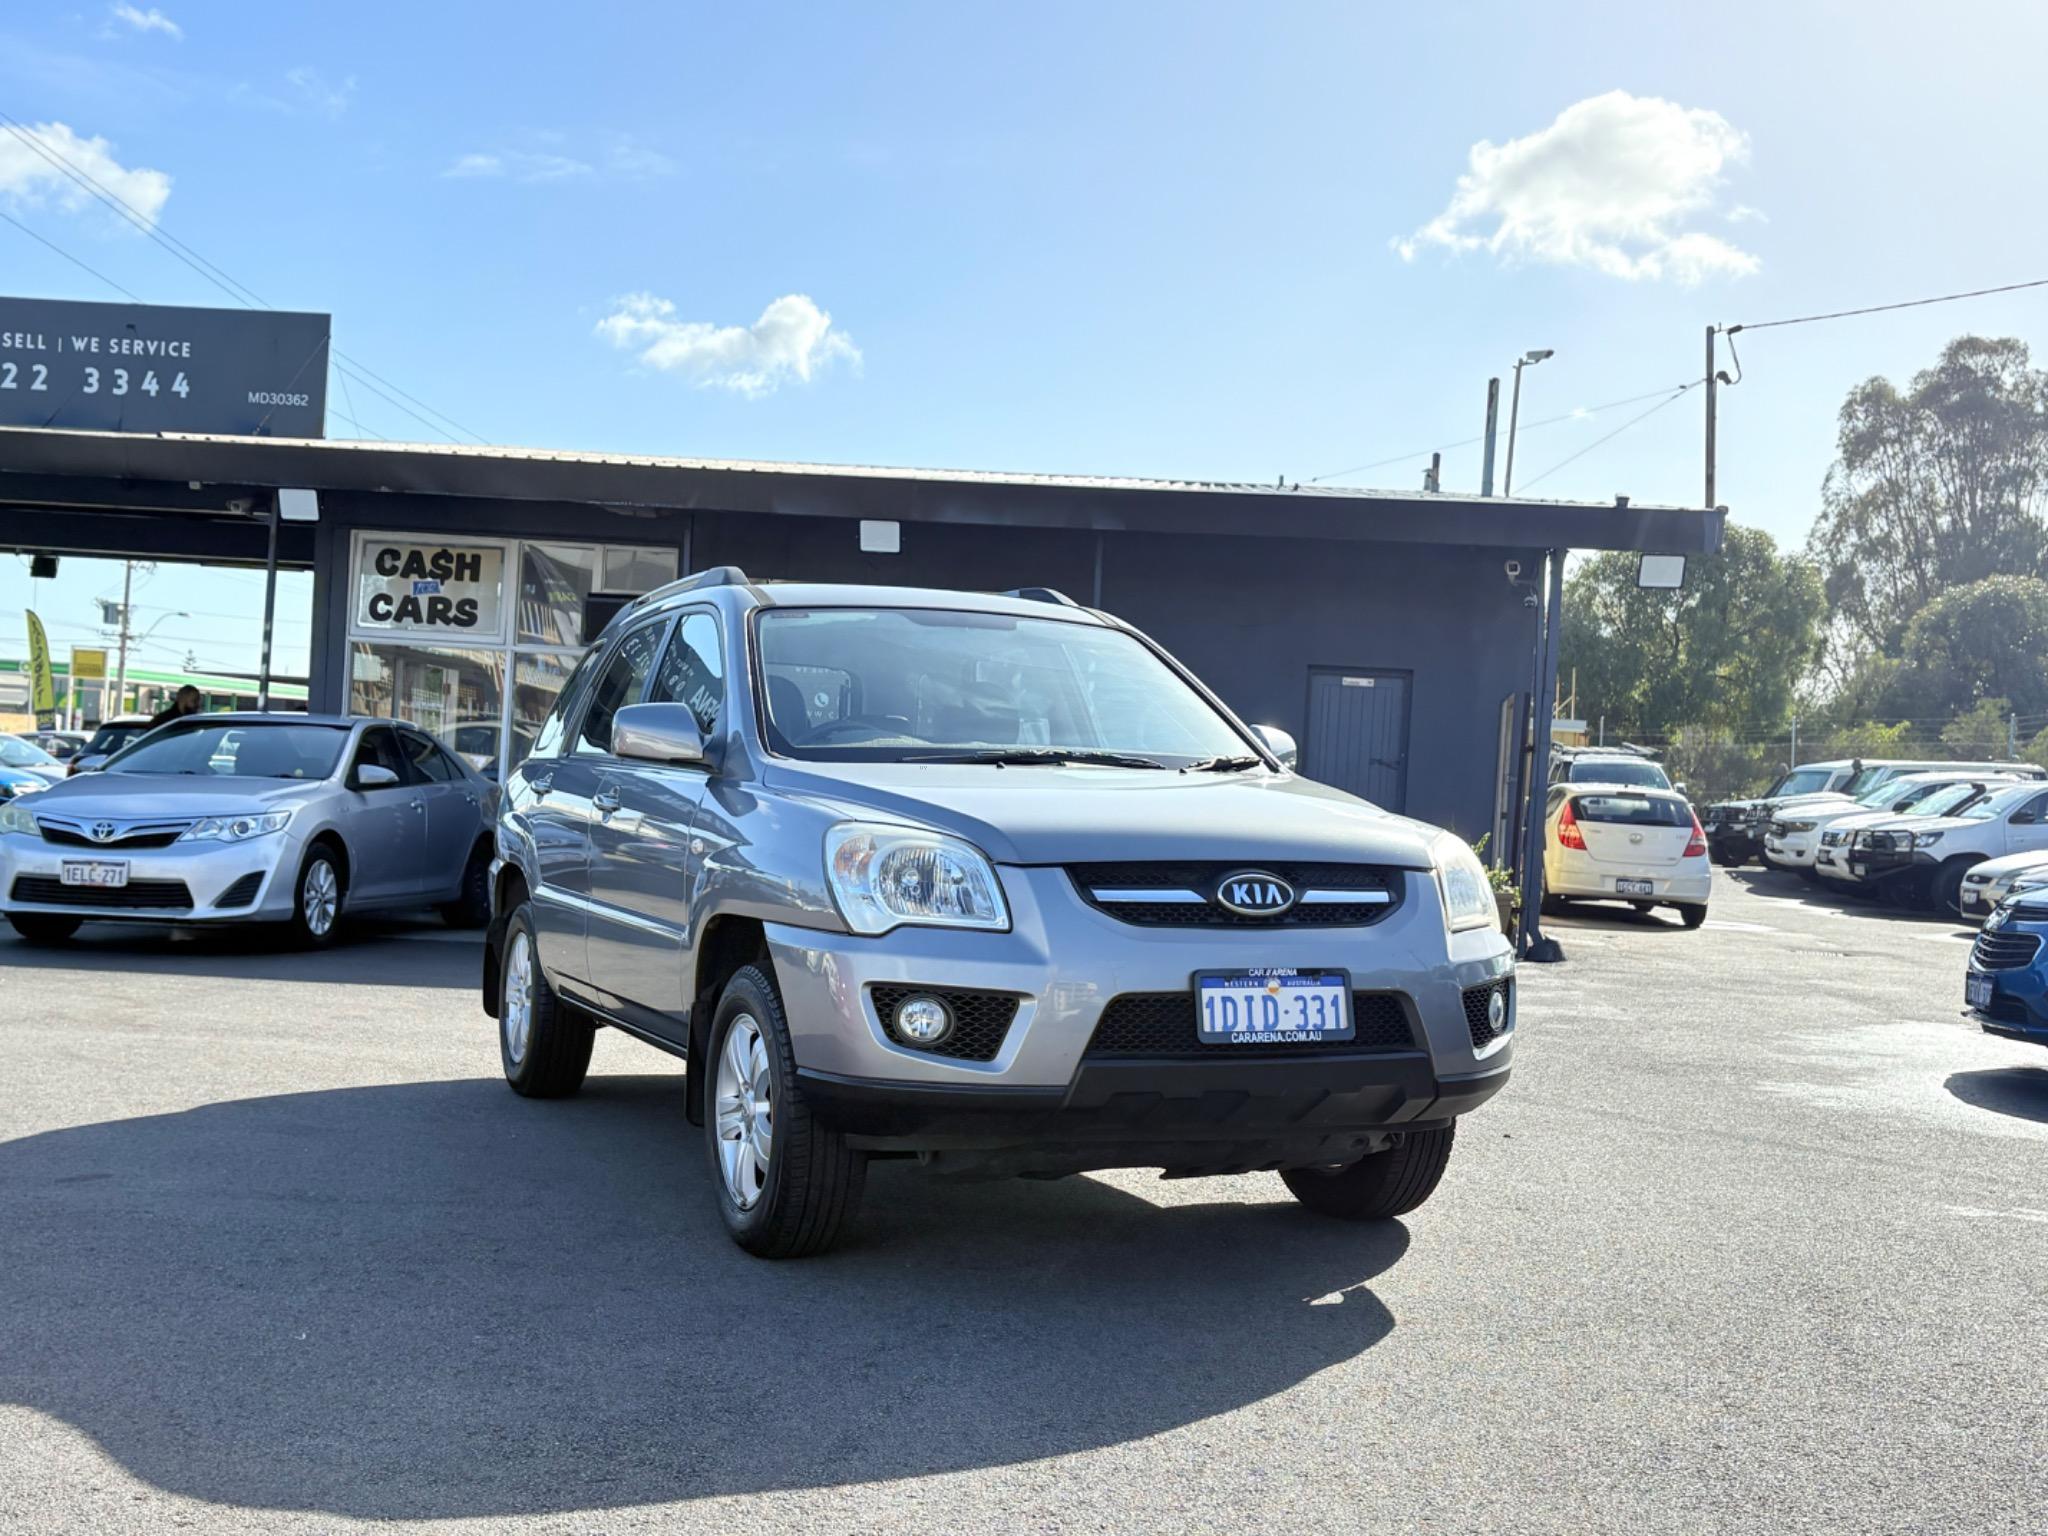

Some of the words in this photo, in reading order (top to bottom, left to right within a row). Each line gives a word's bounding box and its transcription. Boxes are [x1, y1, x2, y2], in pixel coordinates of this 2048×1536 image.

[1, 332, 47, 350] SELL
[71, 335, 100, 353] WE
[109, 338, 191, 358] SERVICE
[0, 362, 48, 391] 22
[83, 366, 190, 399] 3344
[247, 391, 309, 407] MD30362
[375, 548, 482, 586] CA$H
[368, 593, 478, 628] CARS
[1231, 883, 1284, 905] KIA
[1224, 980, 1259, 988] WESTERN
[1231, 1031, 1322, 1043] CARARENA.COM.AU
